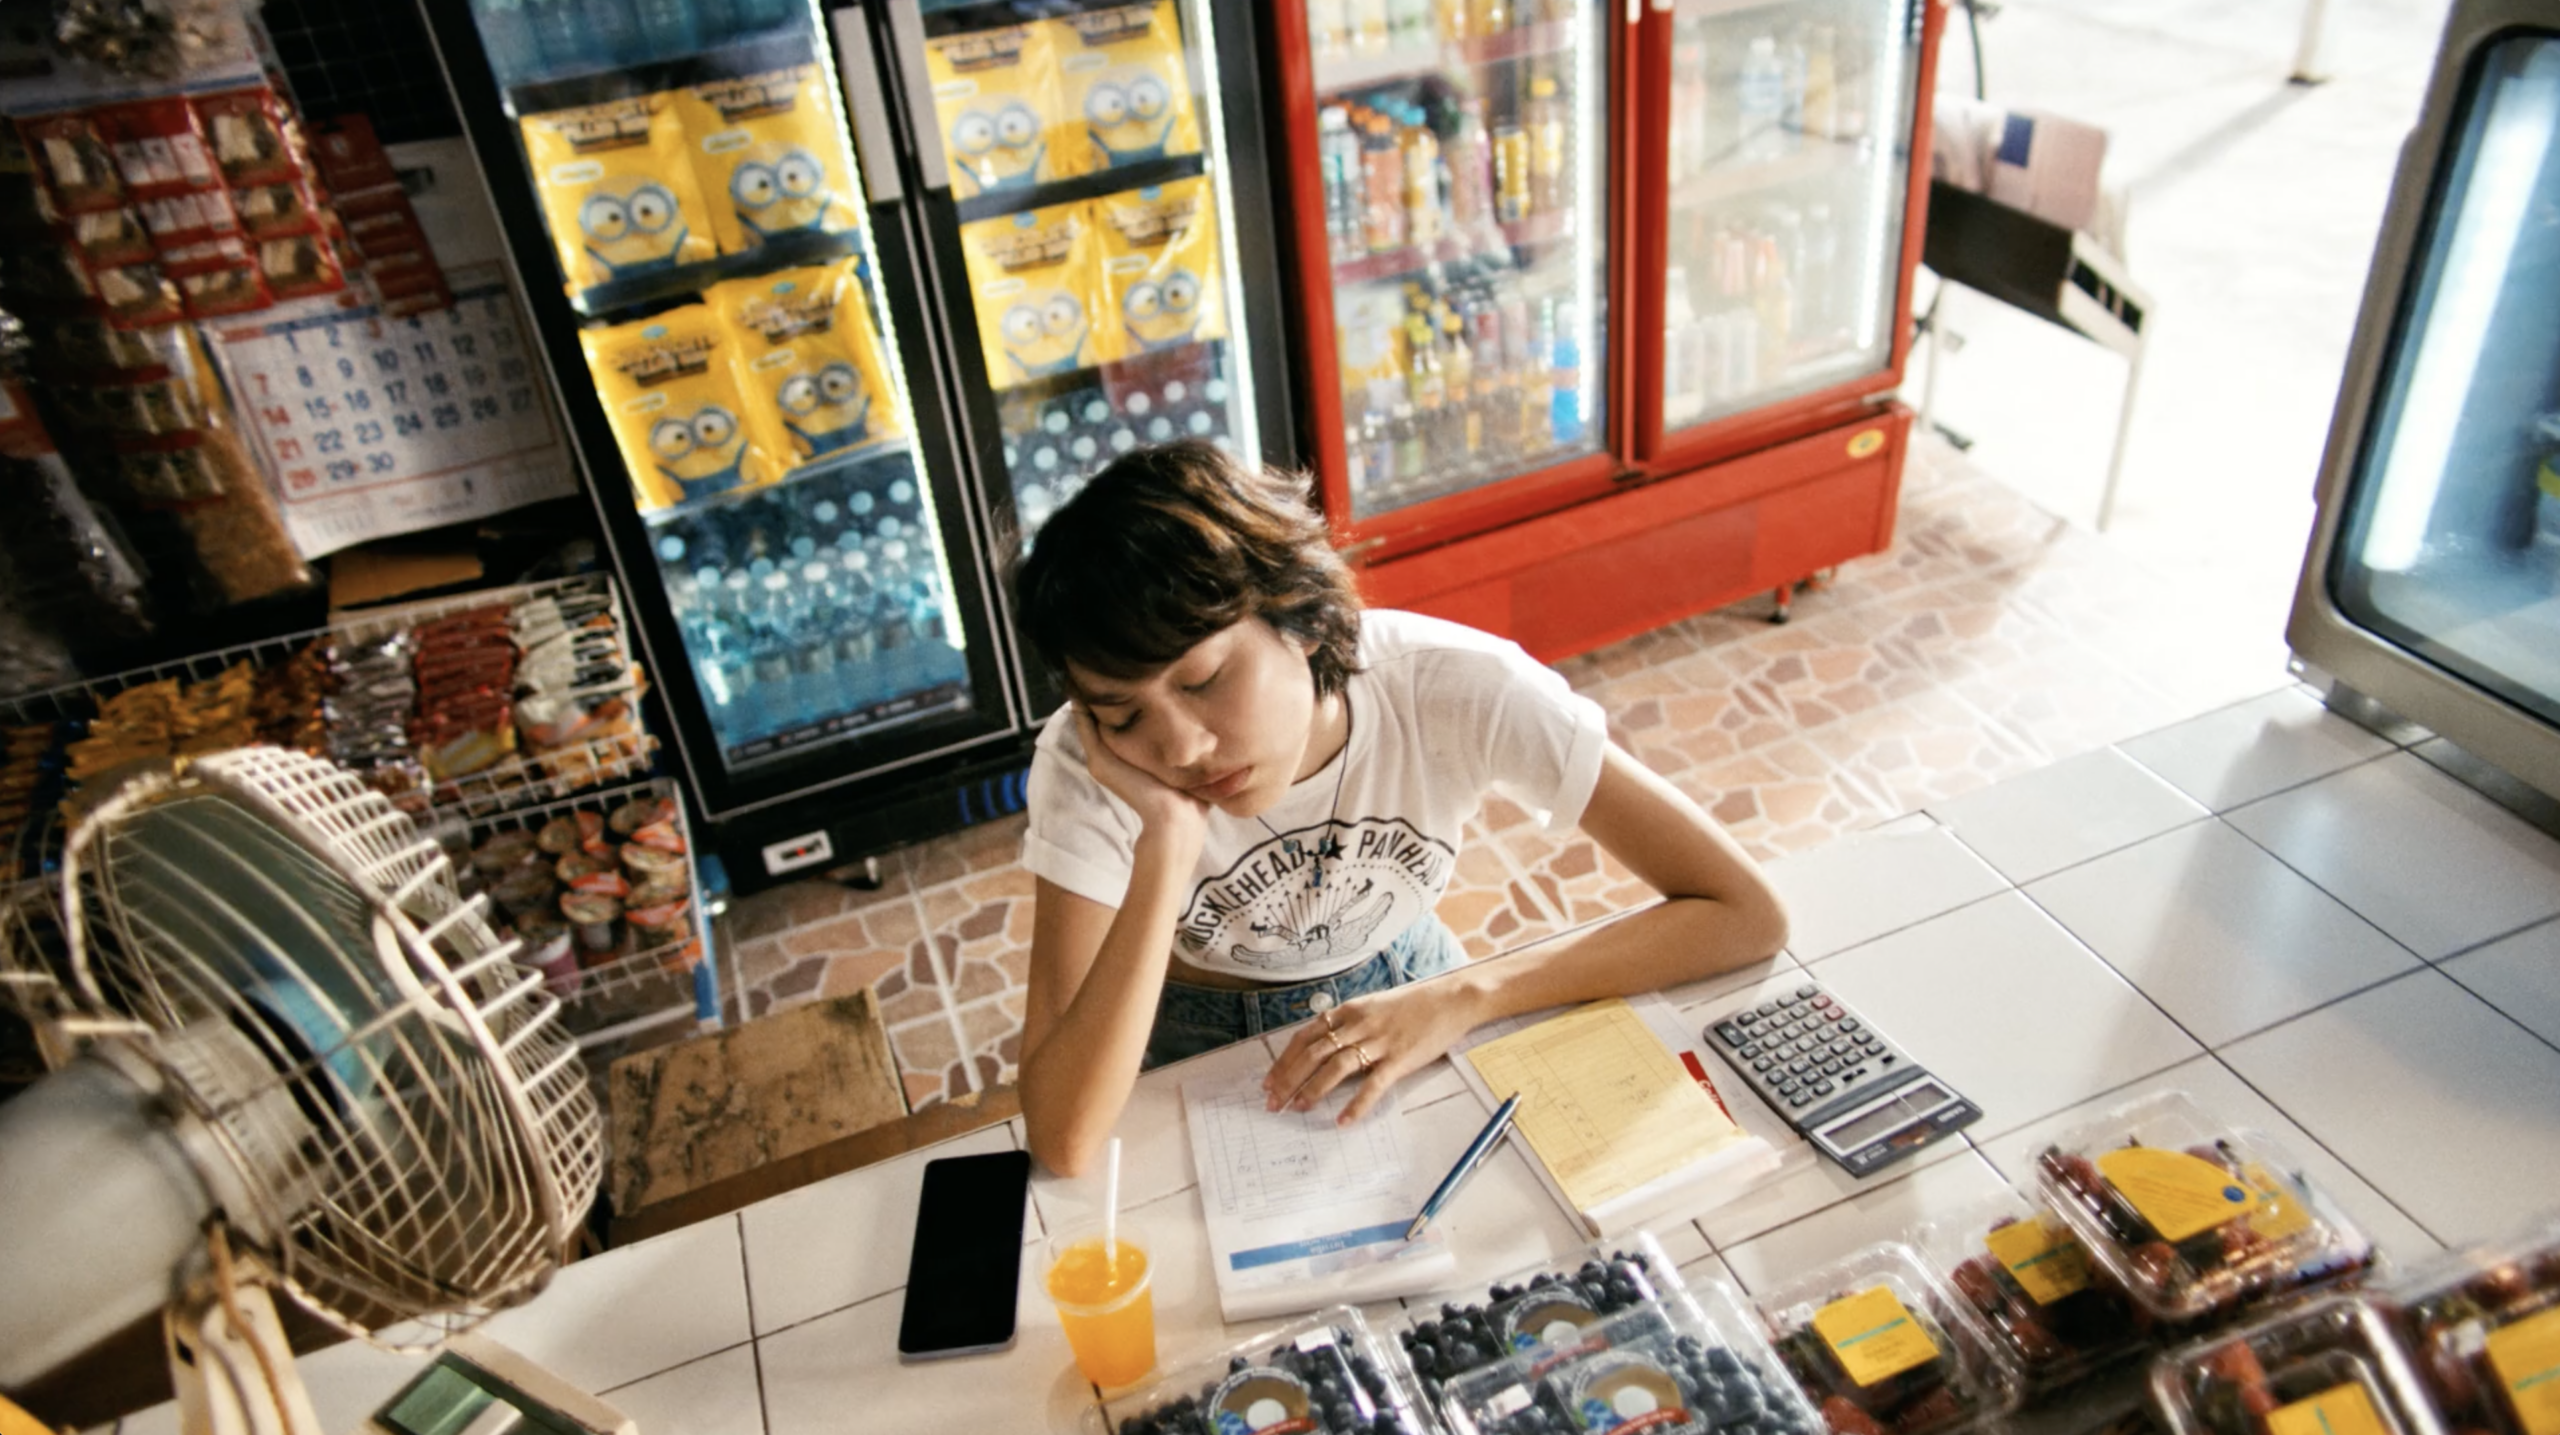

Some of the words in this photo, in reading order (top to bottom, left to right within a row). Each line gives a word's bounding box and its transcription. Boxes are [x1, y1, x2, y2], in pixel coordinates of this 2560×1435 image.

[328, 326, 340, 348] 2
[253, 373, 267, 395] 7
[298, 366, 313, 387] 8
[338, 358, 353, 379] 9
[373, 348, 398, 370] 10
[415, 342, 436, 361] 11
[453, 335, 475, 357] 12
[262, 406, 291, 426] 14
[306, 397, 331, 419] 15
[345, 391, 370, 410] 16
[384, 381, 407, 403] 17
[424, 373, 448, 395] 18
[275, 438, 304, 460] 21
[314, 430, 343, 452] 22
[355, 421, 383, 443] 23
[394, 412, 421, 435] 24
[433, 404, 459, 428] 25
[471, 397, 497, 419] 26
[327, 460, 354, 480] 29
[367, 452, 394, 472] 30
